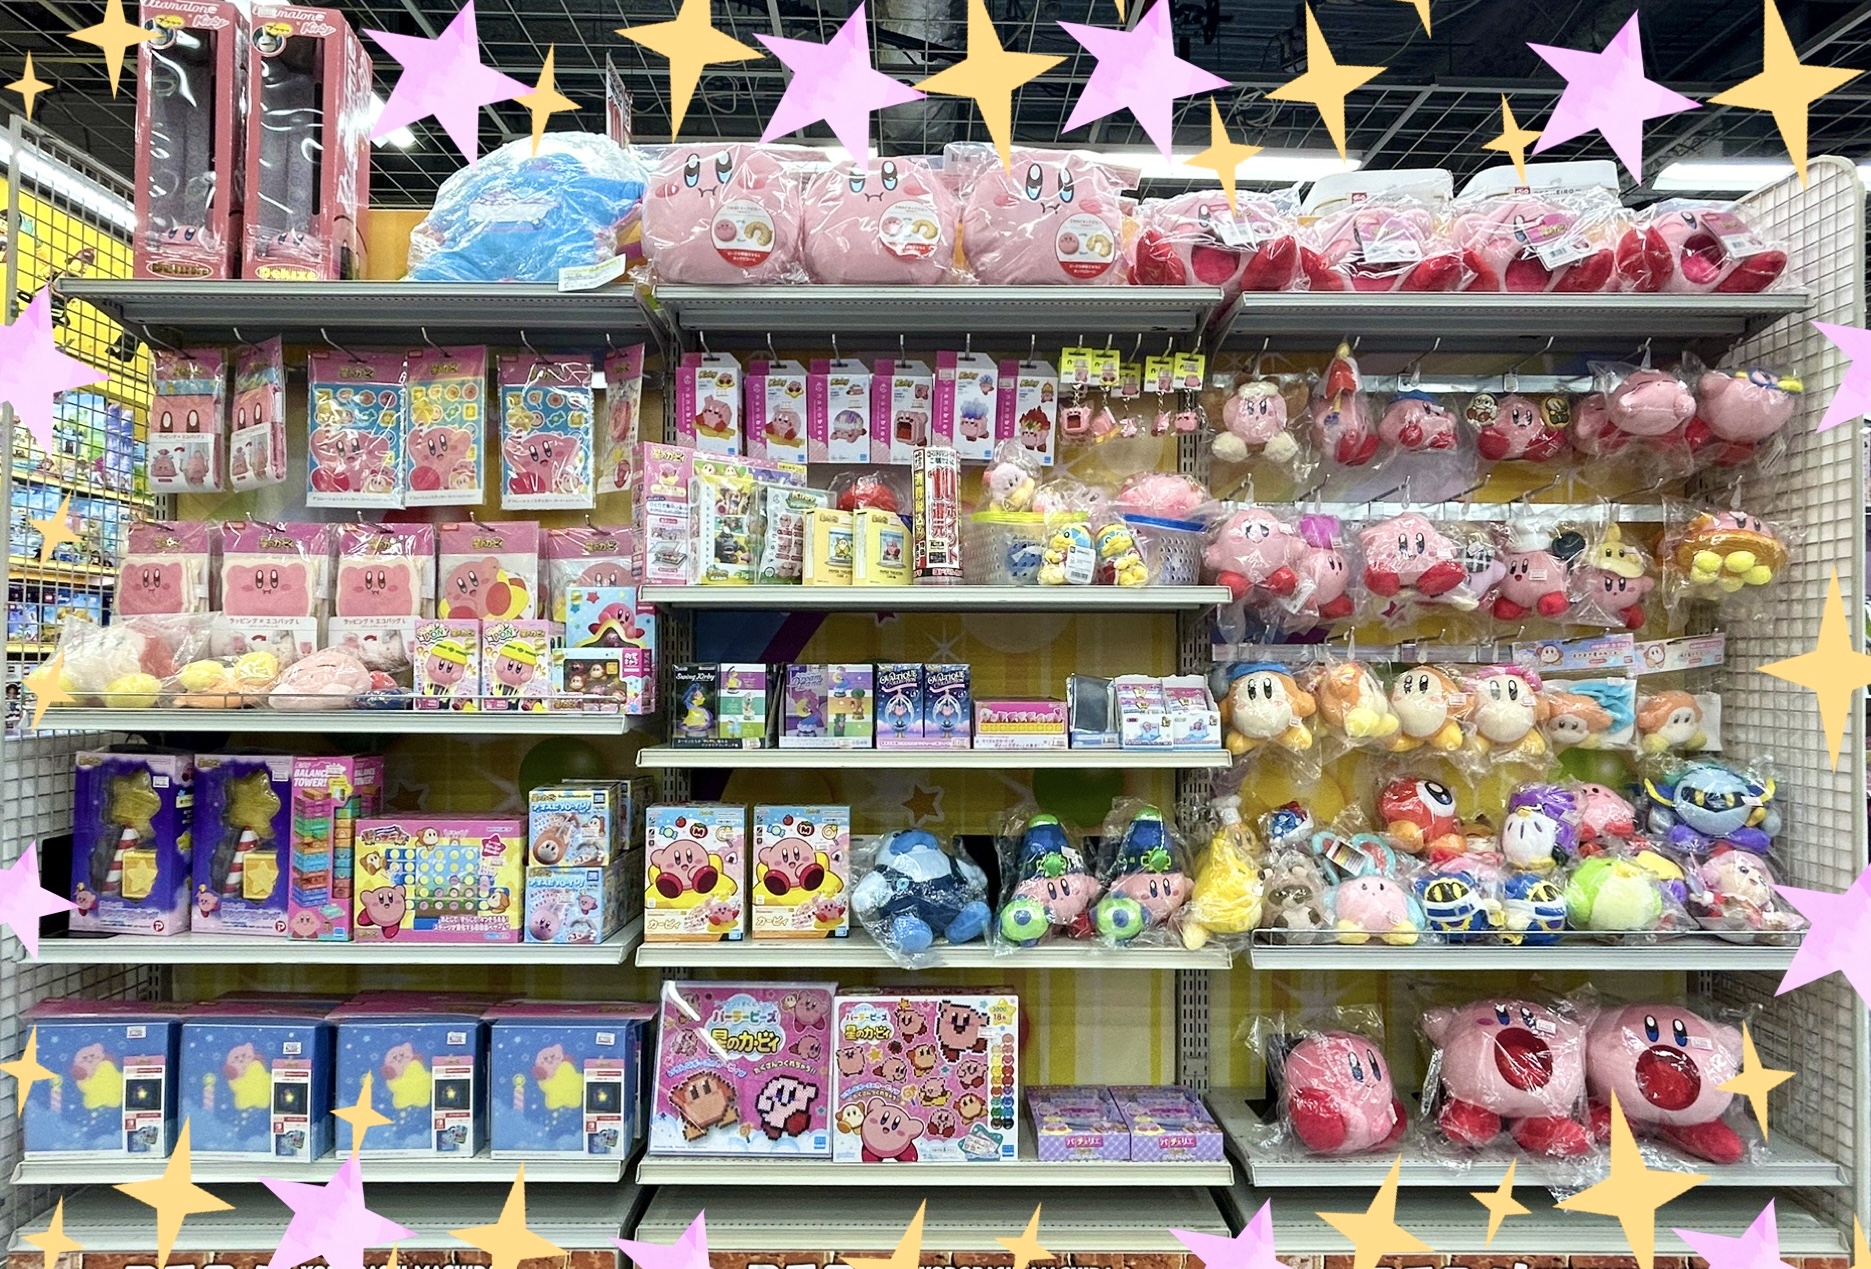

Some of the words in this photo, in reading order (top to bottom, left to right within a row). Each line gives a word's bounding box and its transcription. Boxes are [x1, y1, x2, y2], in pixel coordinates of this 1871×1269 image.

[260, 265, 317, 280] Deluxe
[294, 778, 327, 787] TOWER!
[647, 919, 681, 931] カービィ
[755, 916, 789, 928] カービィ
[712, 1010, 778, 1024] パーラービーズ
[846, 1014, 888, 1022] パーラービーズ
[1067, 1137, 1101, 1146] パチュリエ
[1160, 1137, 1194, 1146] パチュリエ
